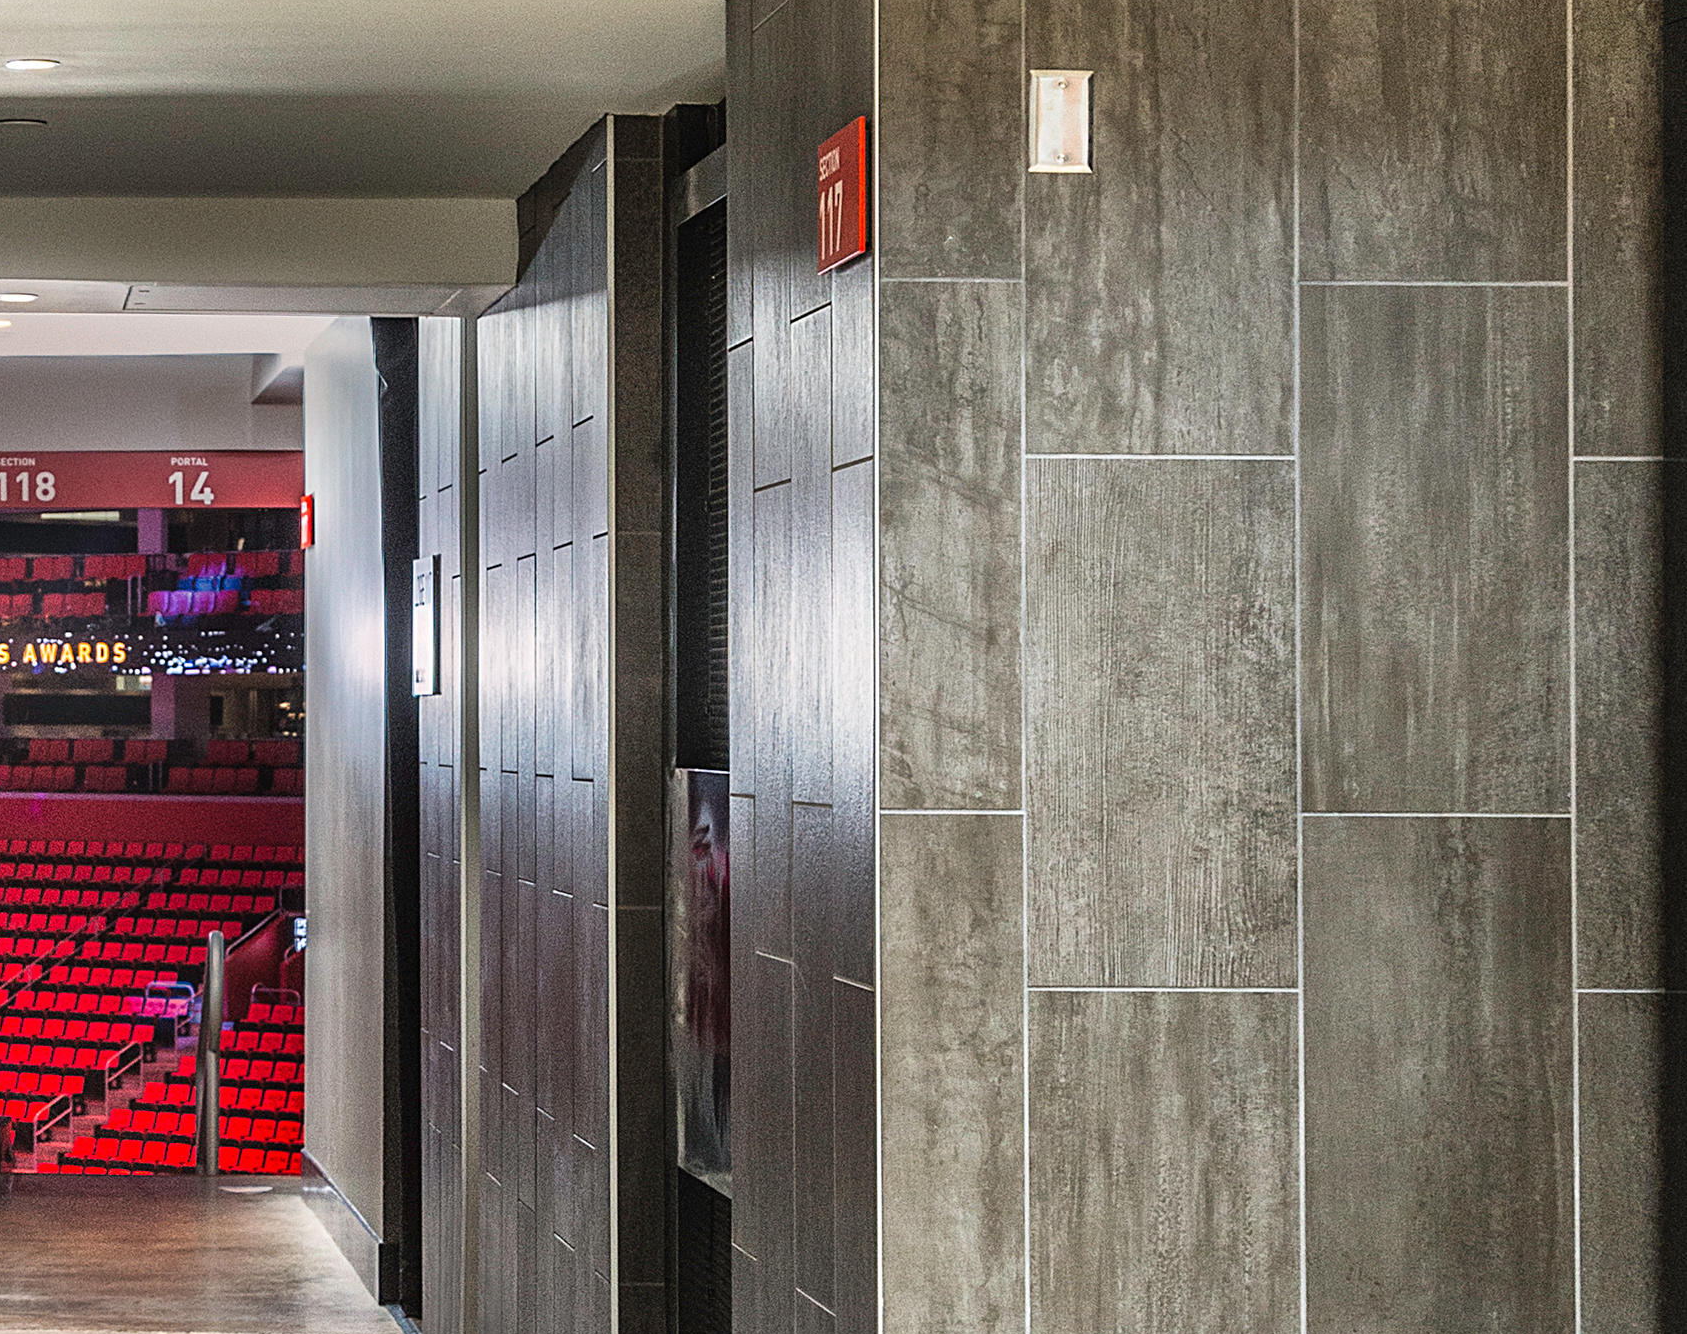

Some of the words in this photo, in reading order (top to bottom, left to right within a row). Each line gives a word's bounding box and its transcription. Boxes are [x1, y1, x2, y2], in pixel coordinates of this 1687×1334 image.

[819, 146, 841, 182] SECTION
[819, 179, 843, 261] 117
[170, 457, 208, 467] PORTAL
[168, 471, 215, 505] 14
[22, 641, 127, 665] AWARDS
